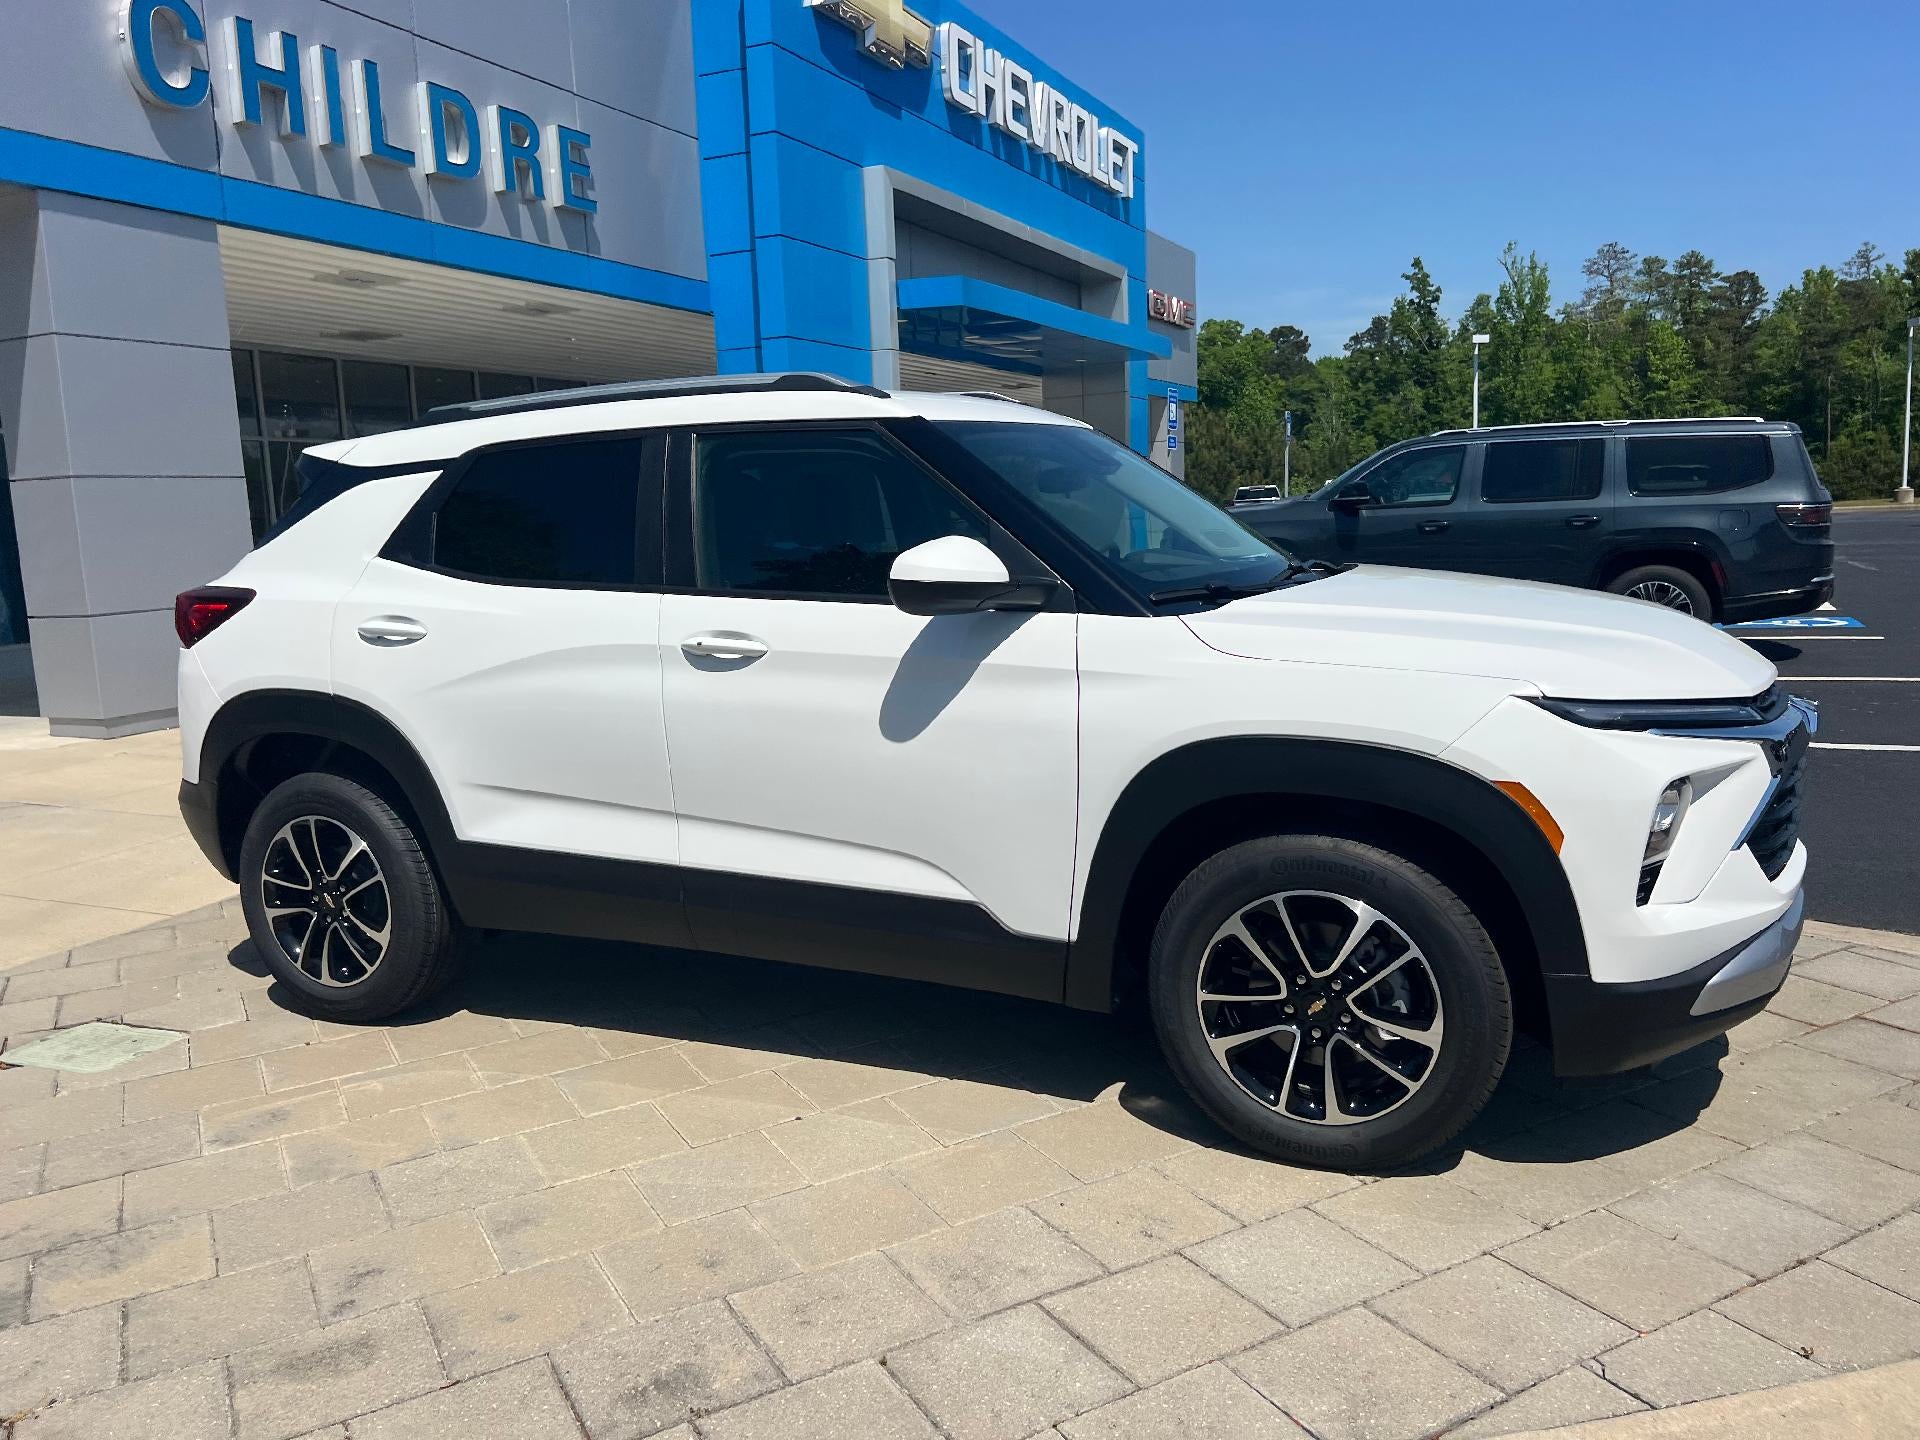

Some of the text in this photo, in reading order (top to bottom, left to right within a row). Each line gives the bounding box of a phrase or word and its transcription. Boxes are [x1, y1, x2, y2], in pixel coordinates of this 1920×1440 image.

[120, 0, 597, 213] CHILDRE
[940, 21, 1139, 199] CHEVROLET
[1148, 288, 1195, 329] GMC
